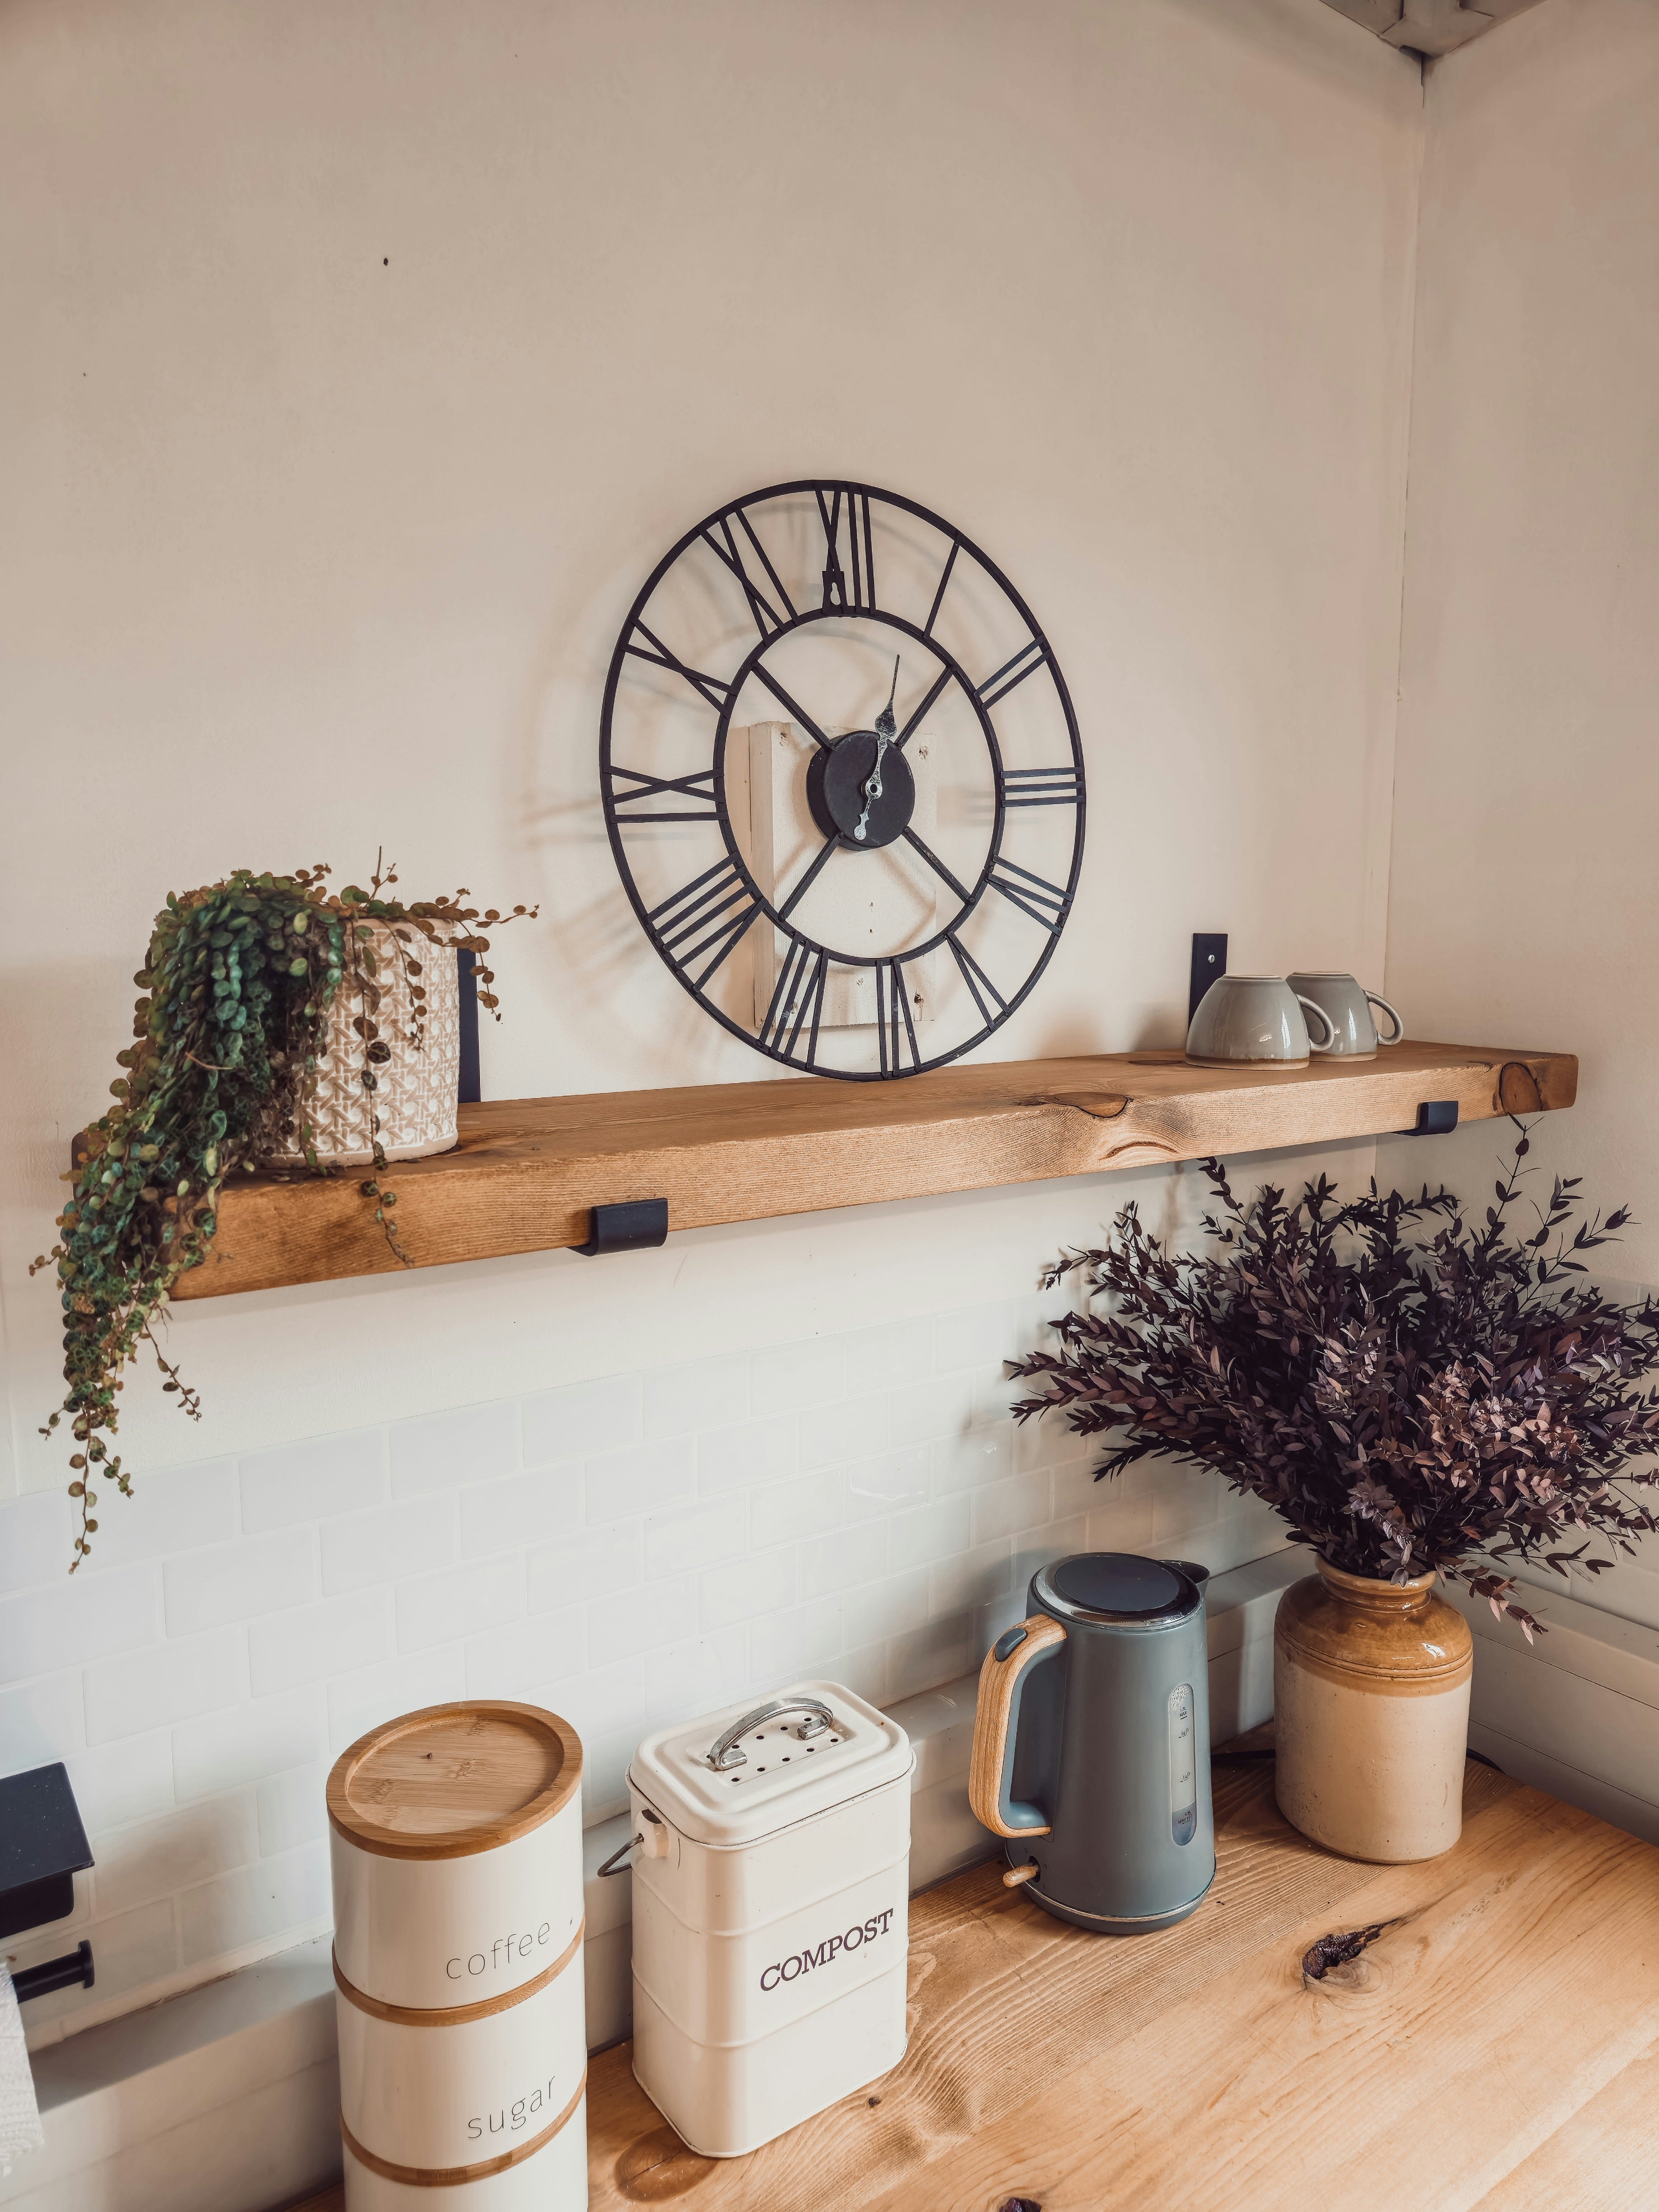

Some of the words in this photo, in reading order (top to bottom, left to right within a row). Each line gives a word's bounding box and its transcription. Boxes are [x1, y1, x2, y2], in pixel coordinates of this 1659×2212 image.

[698, 509, 799, 642] XI
[815, 488, 877, 614] XII
[923, 541, 961, 638] I
[622, 619, 738, 719] X
[974, 636, 1052, 712] II
[605, 765, 728, 823] IX
[1001, 767, 1083, 807] III
[988, 855, 1073, 936] IV
[876, 959, 922, 1078] VI
[946, 932, 1010, 1032] V
[446, 1922, 550, 1979] coffee
[760, 1907, 894, 1992] COMPOST
[468, 2075, 556, 2139] sugar
